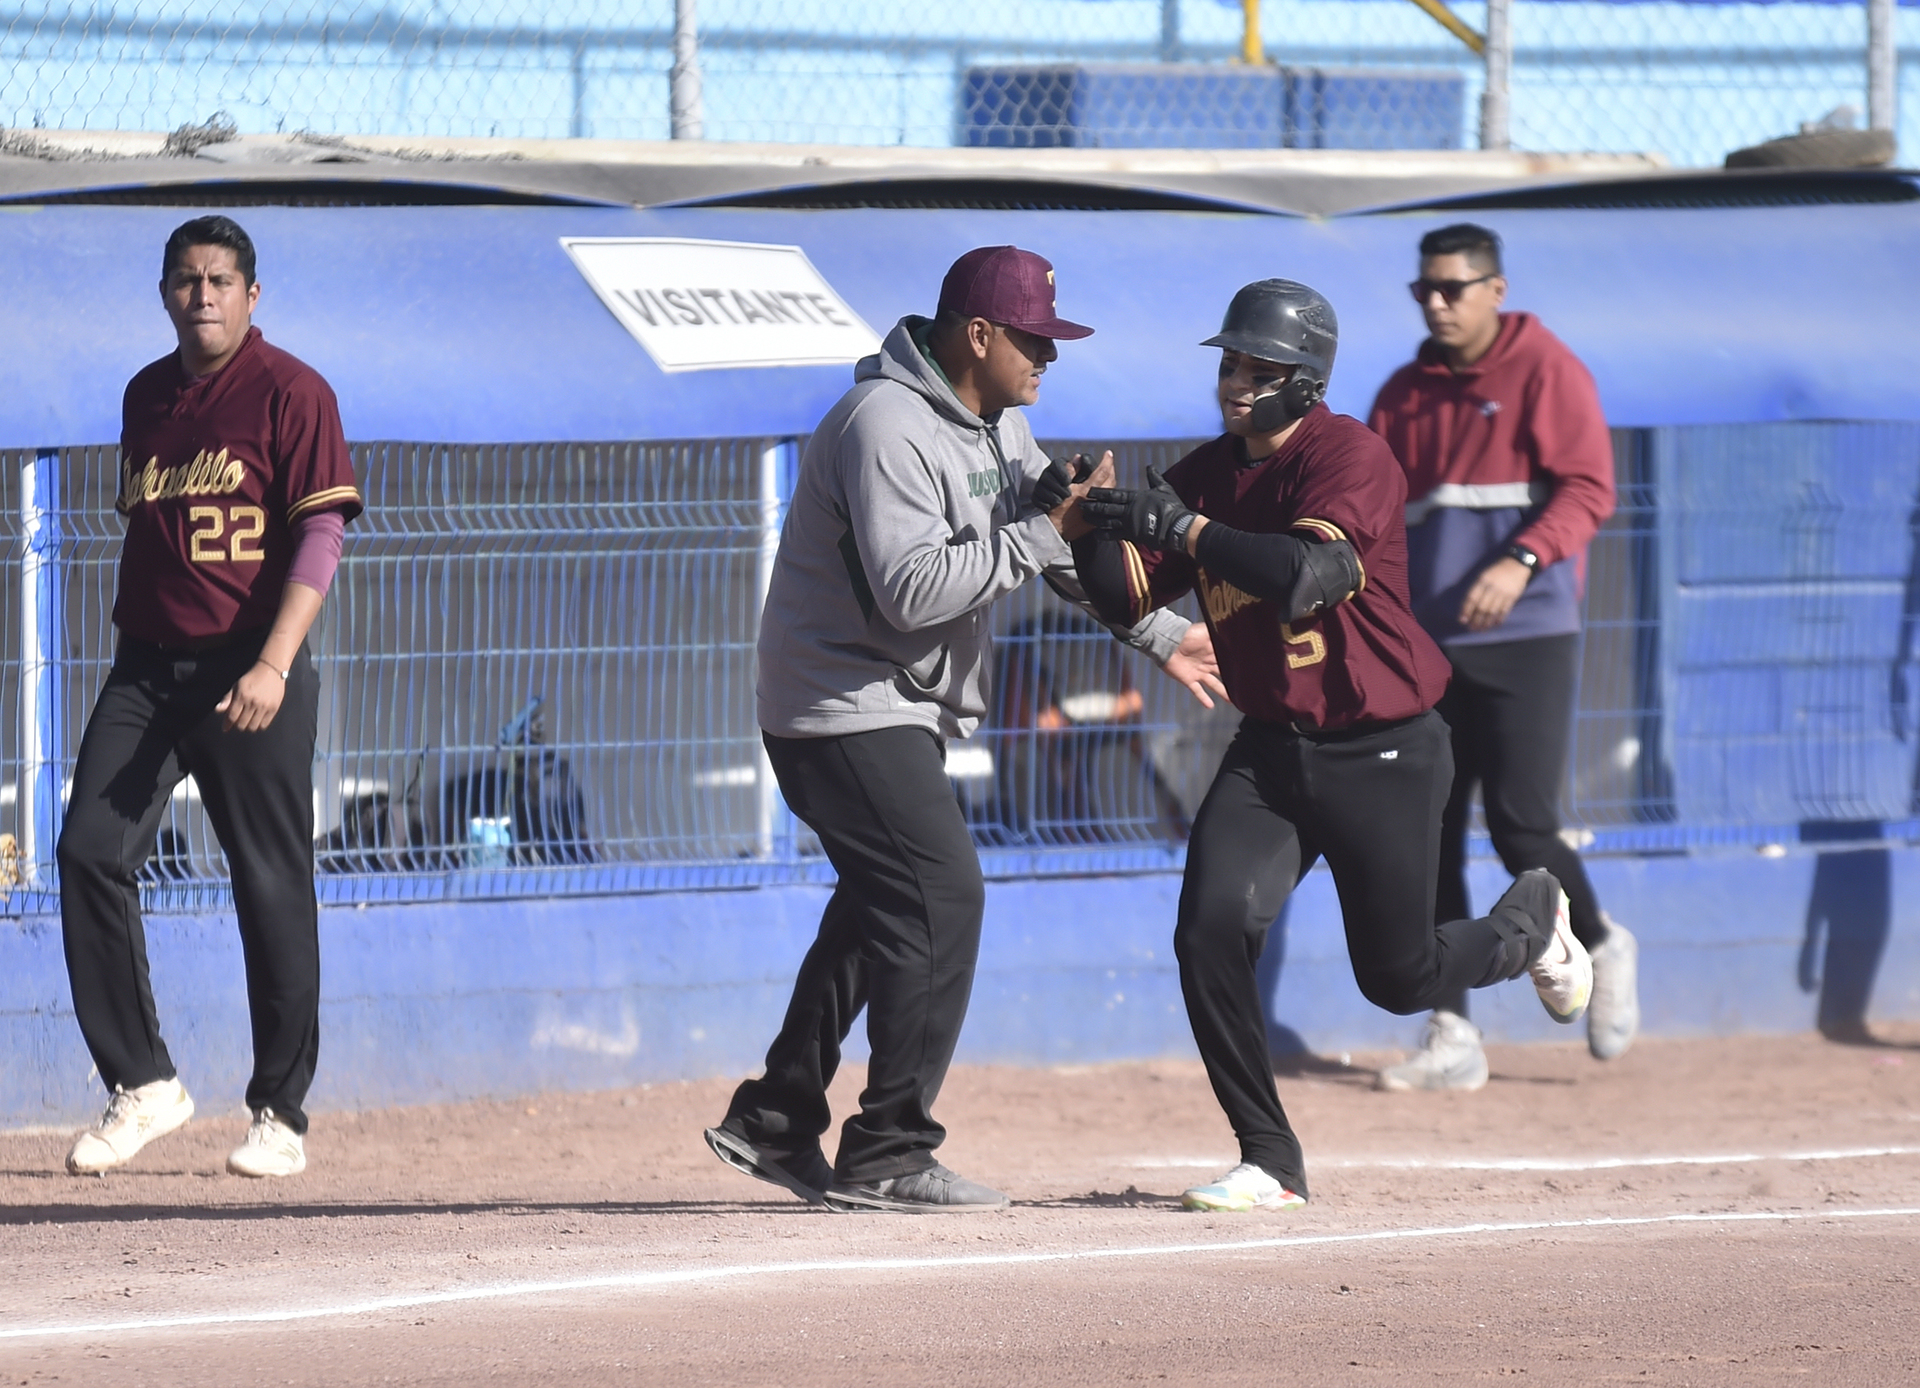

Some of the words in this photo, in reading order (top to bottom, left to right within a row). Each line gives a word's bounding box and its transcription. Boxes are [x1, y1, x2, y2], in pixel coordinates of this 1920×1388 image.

[613, 287, 852, 327] VISITANTE
[189, 505, 265, 562] 22
[1281, 613, 1327, 670] 5
